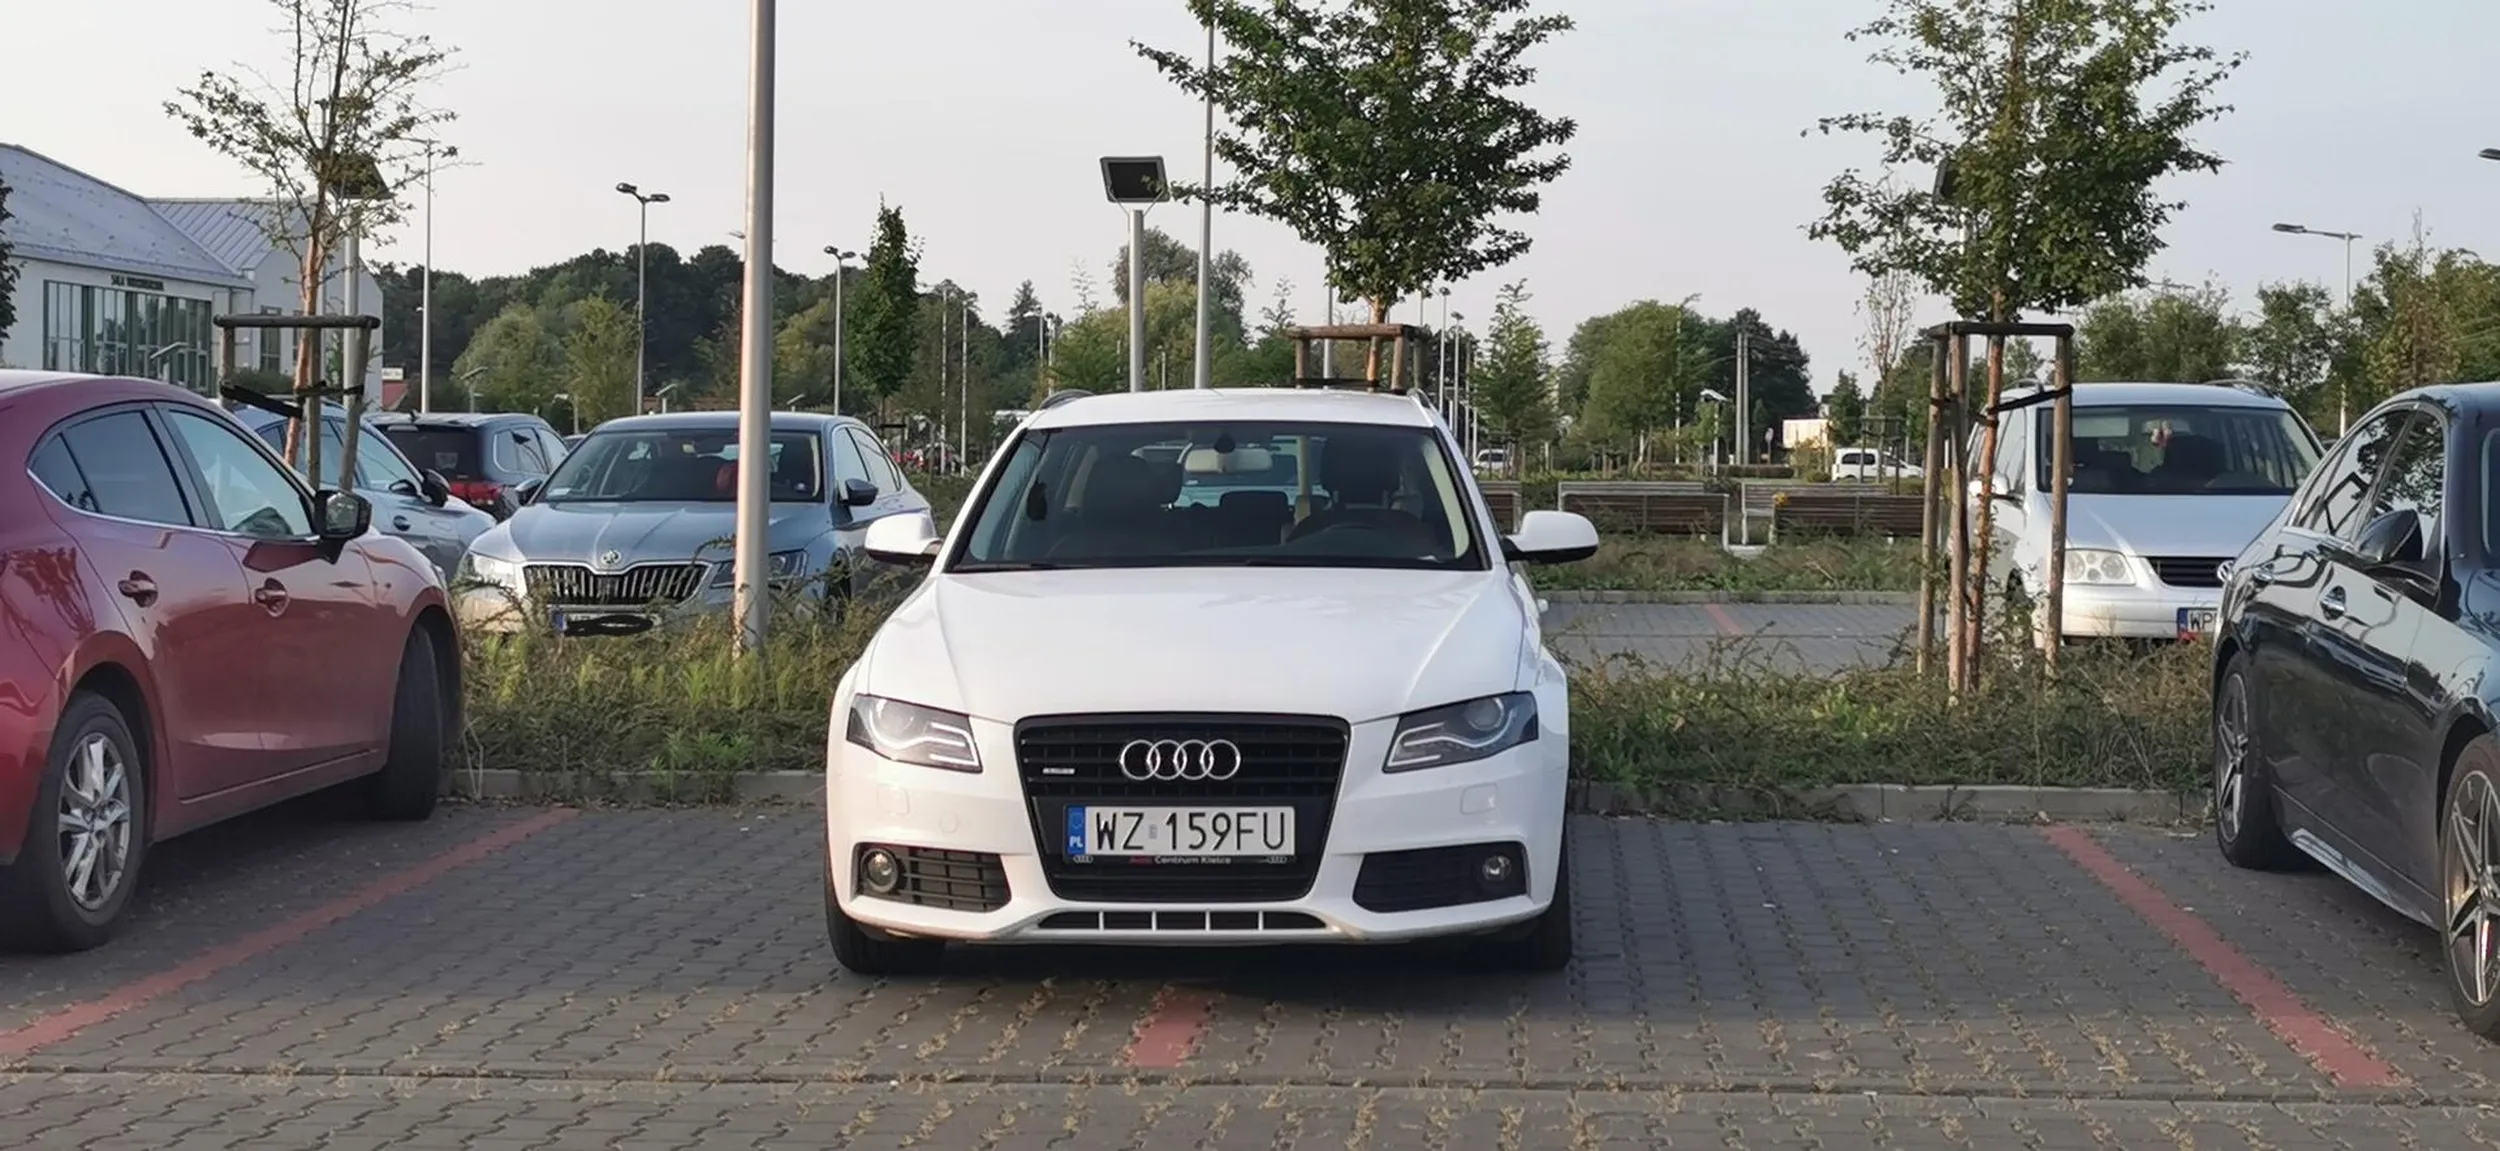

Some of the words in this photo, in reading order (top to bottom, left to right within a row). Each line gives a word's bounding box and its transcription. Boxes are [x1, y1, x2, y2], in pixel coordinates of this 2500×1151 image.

[2190, 612, 2217, 630] WP
[1096, 812, 1144, 851] WZ
[1166, 812, 1285, 851] 159FU
[1069, 836, 1083, 848] PL
[1155, 855, 1198, 865] Centrum
[1201, 855, 1231, 865] Kielce
